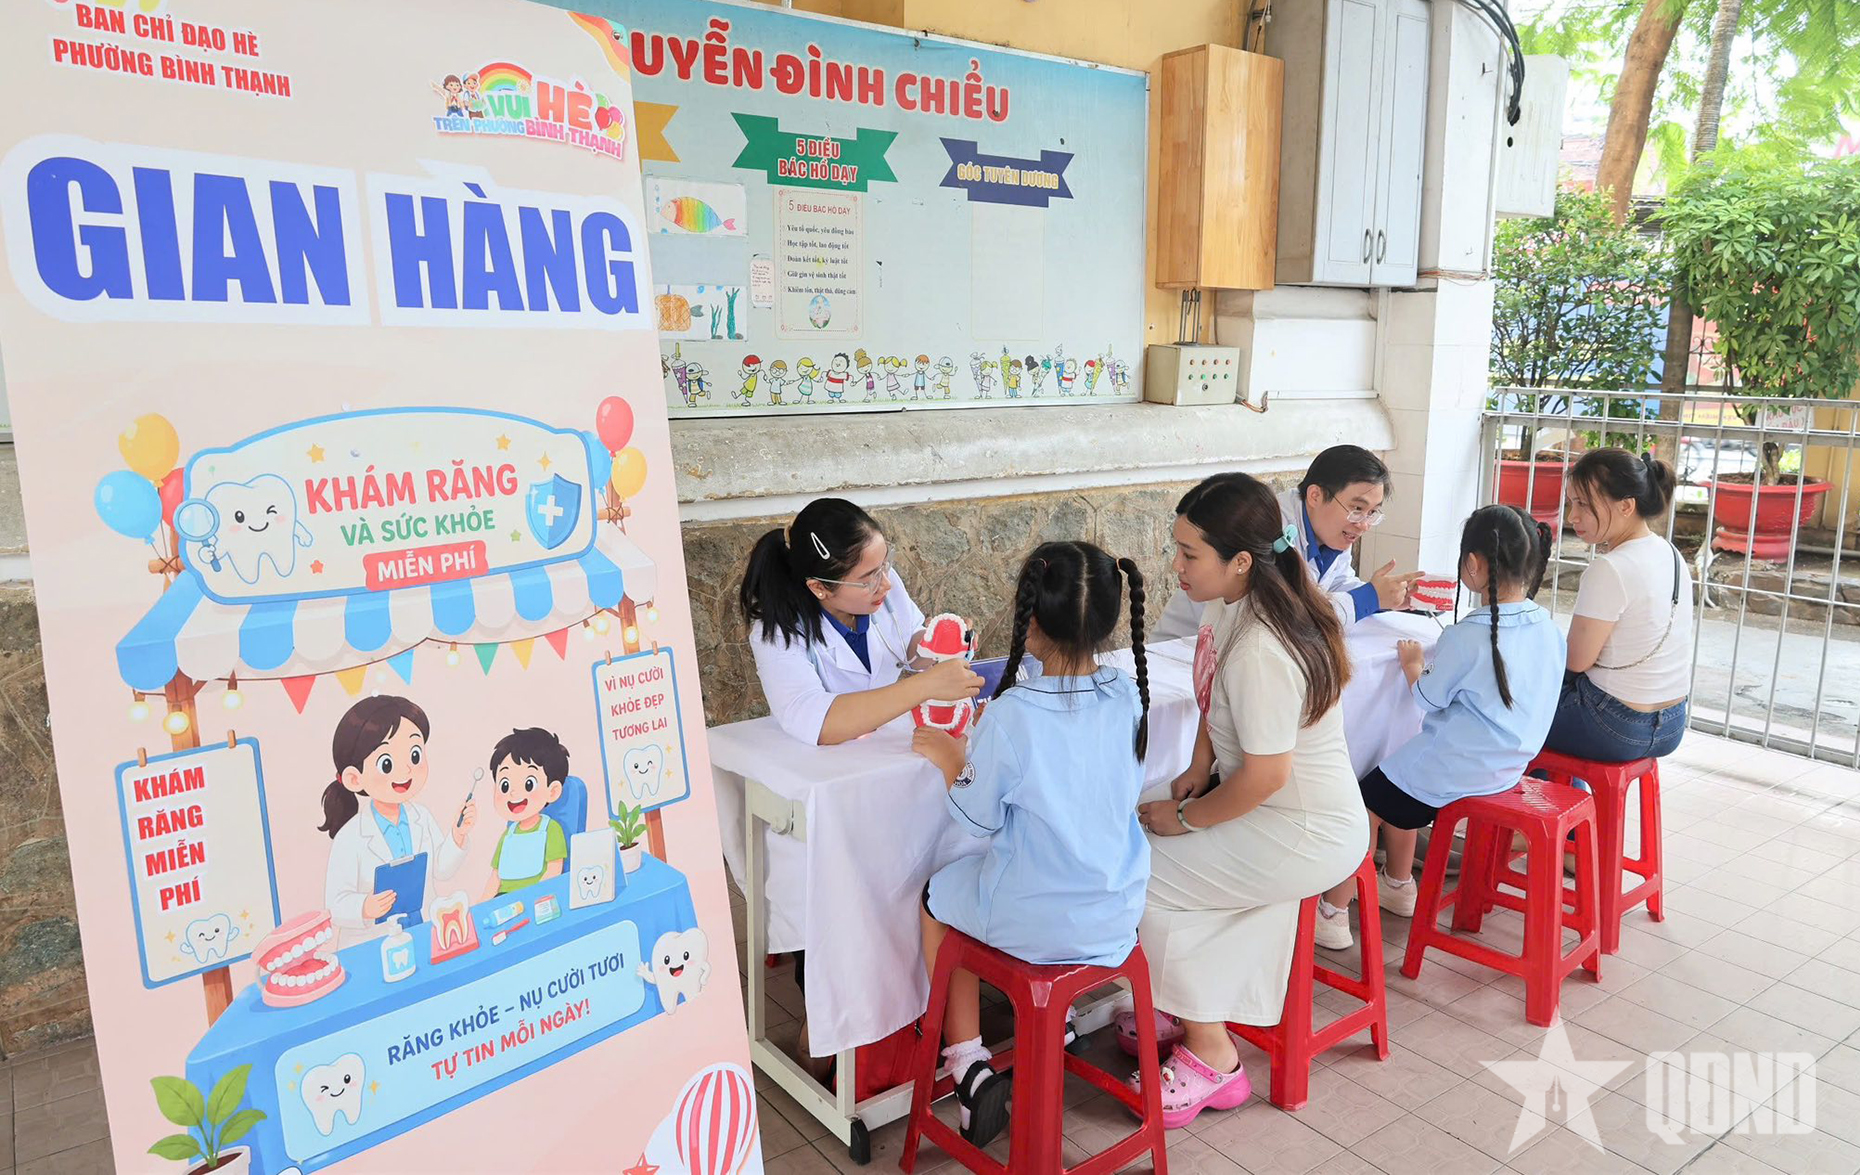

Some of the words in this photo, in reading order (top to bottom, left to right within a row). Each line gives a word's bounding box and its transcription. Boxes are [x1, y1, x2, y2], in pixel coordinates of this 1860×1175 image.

[76, 4, 125, 34] BAN
[133, 14, 175, 42] CHỈ
[181, 22, 226, 52] ĐẠO
[233, 31, 260, 57] HÈ
[53, 38, 153, 76] PHƯỜNG
[161, 55, 216, 86] BÌNH
[221, 66, 291, 97] THẠNH
[631, 19, 762, 90] UYỄN
[770, 44, 884, 107] ĐÌNH
[894, 59, 1010, 122] CHIỂU
[486, 94, 532, 120] VUI
[537, 80, 593, 131] HÈ
[433, 113, 471, 132] TRÊN
[525, 116, 564, 140] BÌNH
[569, 128, 622, 158] THẠNH
[796, 138, 806, 156] 5
[808, 136, 840, 159] ĐIỀU
[778, 157, 807, 178] BÁC
[809, 158, 828, 180] HỒ
[831, 163, 858, 185] DẠY
[957, 161, 982, 181] GÓC
[982, 165, 1020, 186] TUYÊN
[1021, 169, 1059, 190] DƯƠNG
[788, 199, 794, 211] 5
[27, 156, 352, 306] GIAN
[385, 182, 640, 315] HÀNG
[305, 465, 416, 514] KHÁM
[426, 459, 519, 503] RĂNG
[340, 517, 375, 546] VÀ
[381, 510, 429, 541] SỨC
[434, 504, 496, 534] KHỎE
[377, 550, 436, 582] MIỄN
[441, 546, 477, 573] PHÍ
[605, 675, 617, 691] VÌ
[619, 674, 635, 689] NỤ
[637, 666, 664, 684] CƯỜI
[611, 697, 642, 716] KHỎE
[644, 693, 664, 709] ĐẸP
[612, 721, 650, 740] TƯƠNG
[652, 717, 668, 731] LAI
[133, 766, 205, 802] KHÁM
[137, 804, 204, 840] RĂNG
[145, 838, 205, 876] MIỄN
[160, 876, 201, 911] PHÍ
[386, 1027, 443, 1066] RĂNG
[449, 1004, 501, 1040] KHỎE
[519, 987, 543, 1010] NỤ
[546, 968, 585, 998] CƯỜI
[588, 953, 625, 981] TƯƠI
[430, 1053, 459, 1080] TỰ
[463, 1041, 495, 1067] TIN
[500, 1019, 535, 1052] MỖI
[540, 998, 591, 1035] NGÀY!
